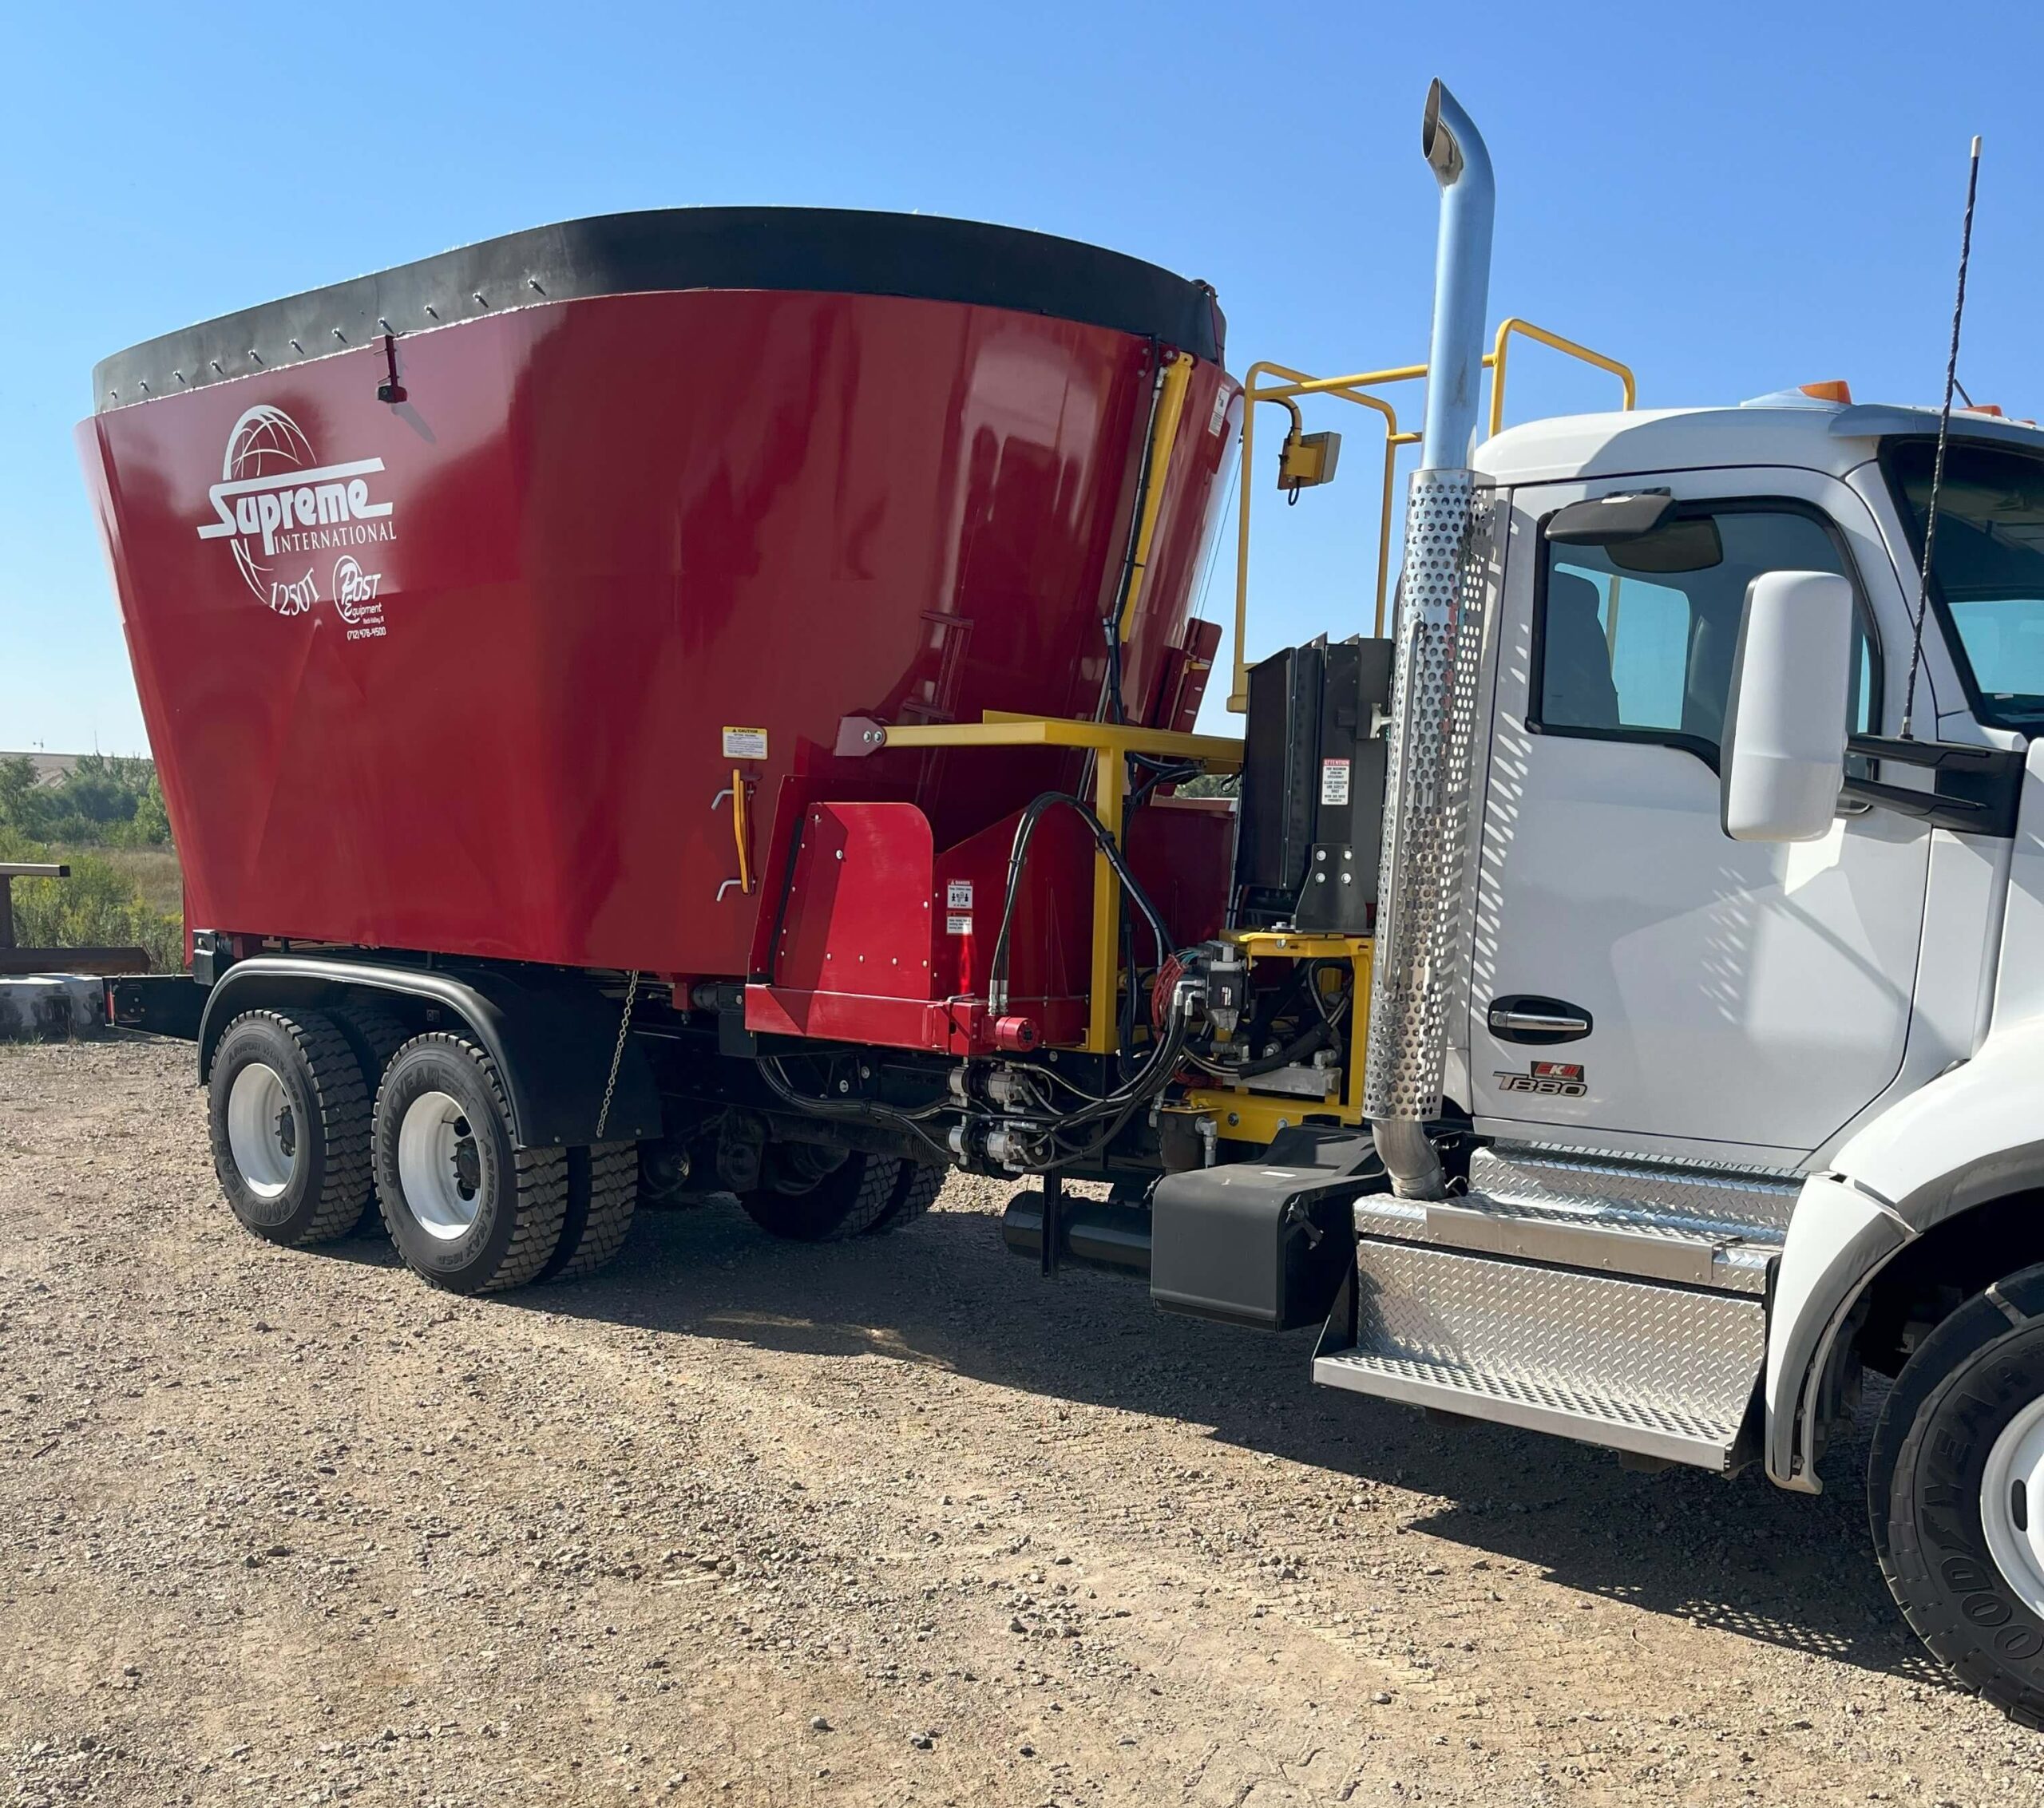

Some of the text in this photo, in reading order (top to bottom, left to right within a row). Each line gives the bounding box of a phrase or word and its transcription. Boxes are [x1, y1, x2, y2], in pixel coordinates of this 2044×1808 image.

[197, 457, 393, 555] Supreme
[275, 521, 397, 553] INTERNATIONAL
[1492, 1071, 1587, 1097] T880
[1920, 1355, 2044, 1682] OODYEAR
